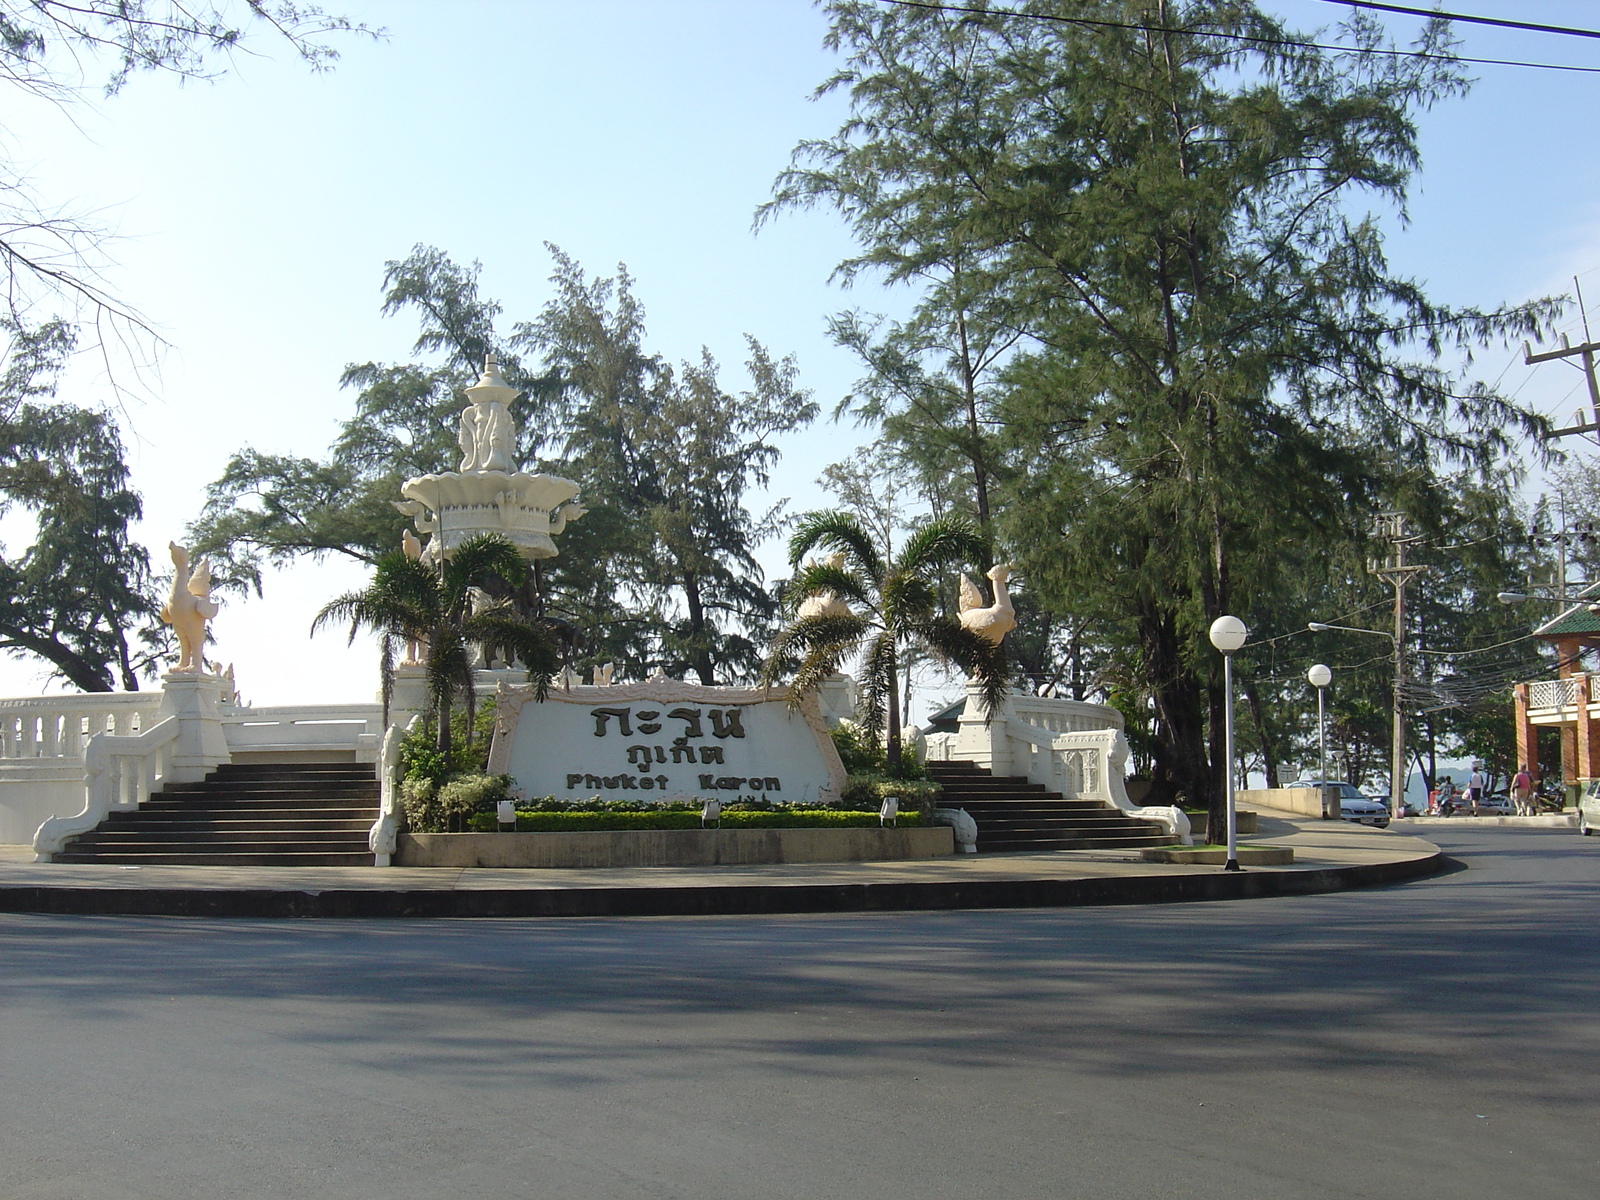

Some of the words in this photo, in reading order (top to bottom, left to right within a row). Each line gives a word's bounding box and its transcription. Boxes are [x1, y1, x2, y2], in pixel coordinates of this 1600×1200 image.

[590, 706, 746, 738] กะรน
[627, 736, 725, 772] ภูเก็ต
[566, 773, 669, 790] Phuket
[698, 773, 781, 791] Karon
